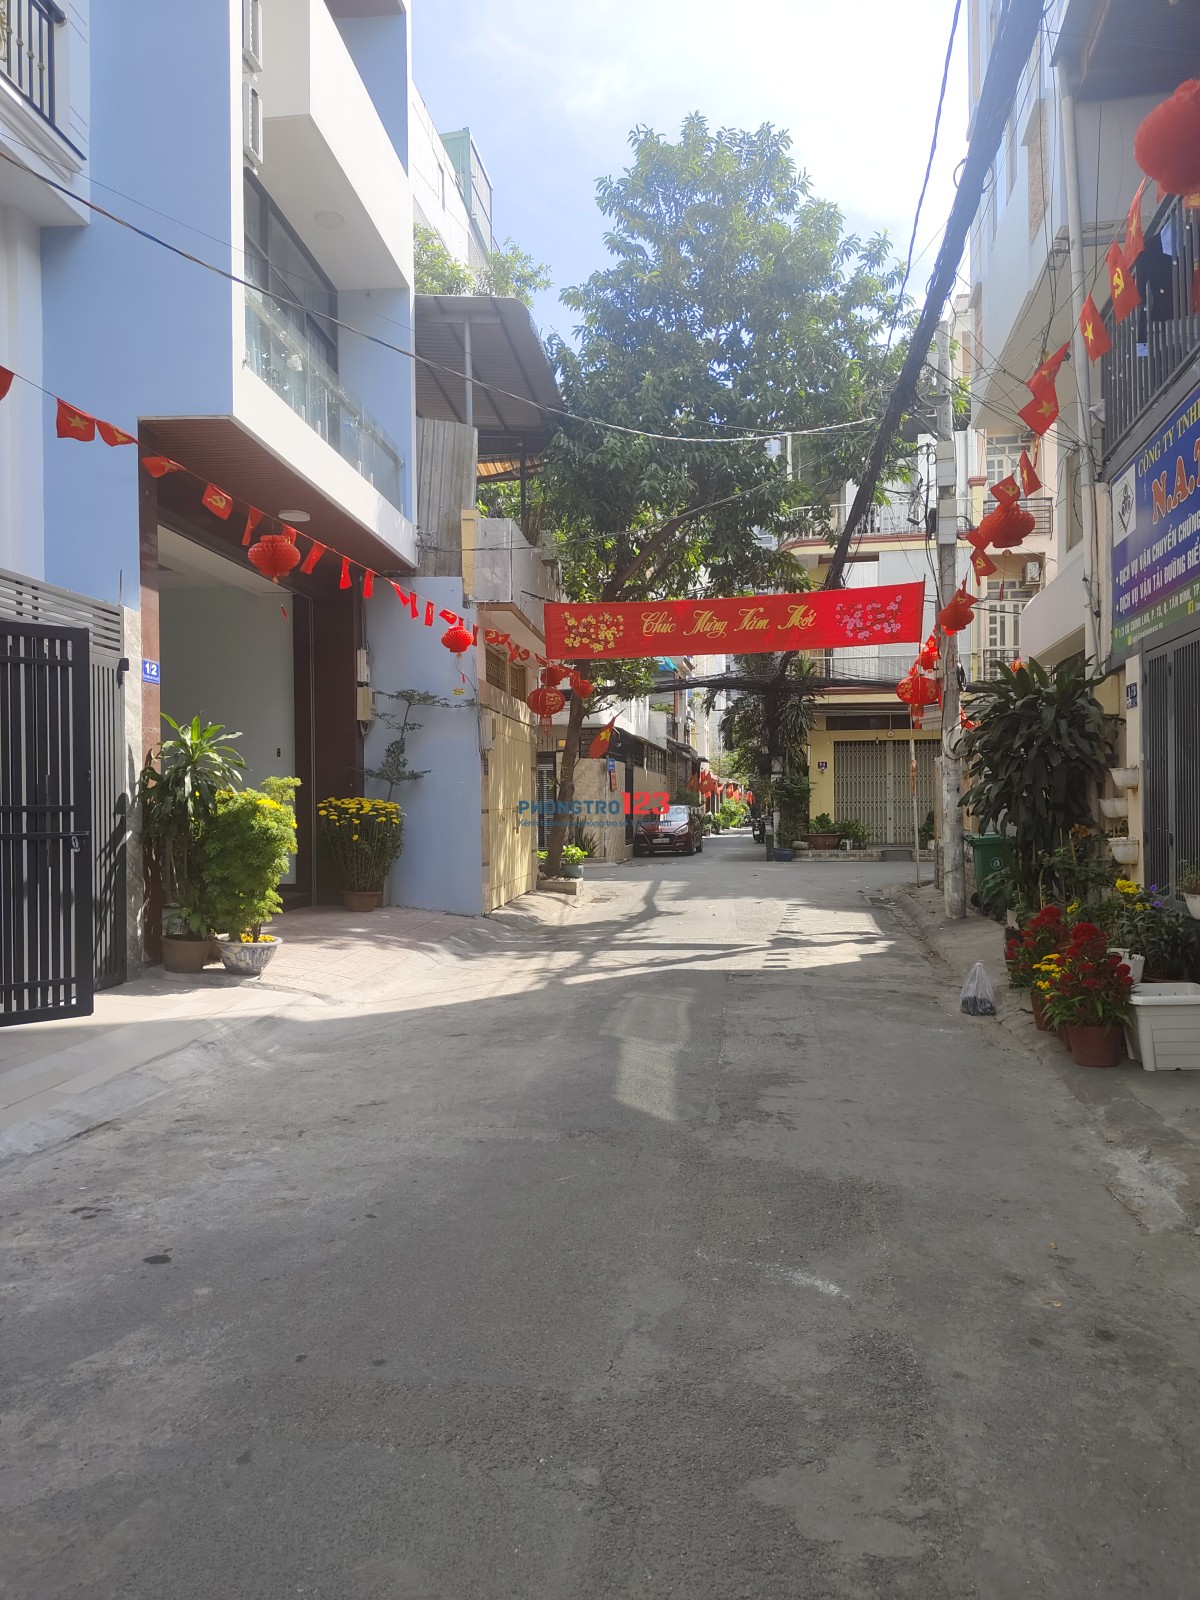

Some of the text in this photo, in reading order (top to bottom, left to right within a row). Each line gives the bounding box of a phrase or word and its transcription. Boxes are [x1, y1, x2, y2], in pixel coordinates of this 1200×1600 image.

[1138, 441, 1161, 477] CÔNG
[1163, 425, 1174, 453] TY
[1120, 564, 1131, 587] DỊCH
[1131, 558, 1138, 578] VỤ
[1139, 548, 1151, 572] VẬN
[1152, 523, 1176, 562] CHUYỂN
[1120, 591, 1131, 614] DỊCH
[1131, 586, 1139, 607] VỤ
[1140, 577, 1152, 601] VẬN
[1153, 565, 1163, 592] TẢI
[1187, 536, 1200, 570] BIỂ
[641, 604, 817, 639] Chúc Mừng Năm Mới
